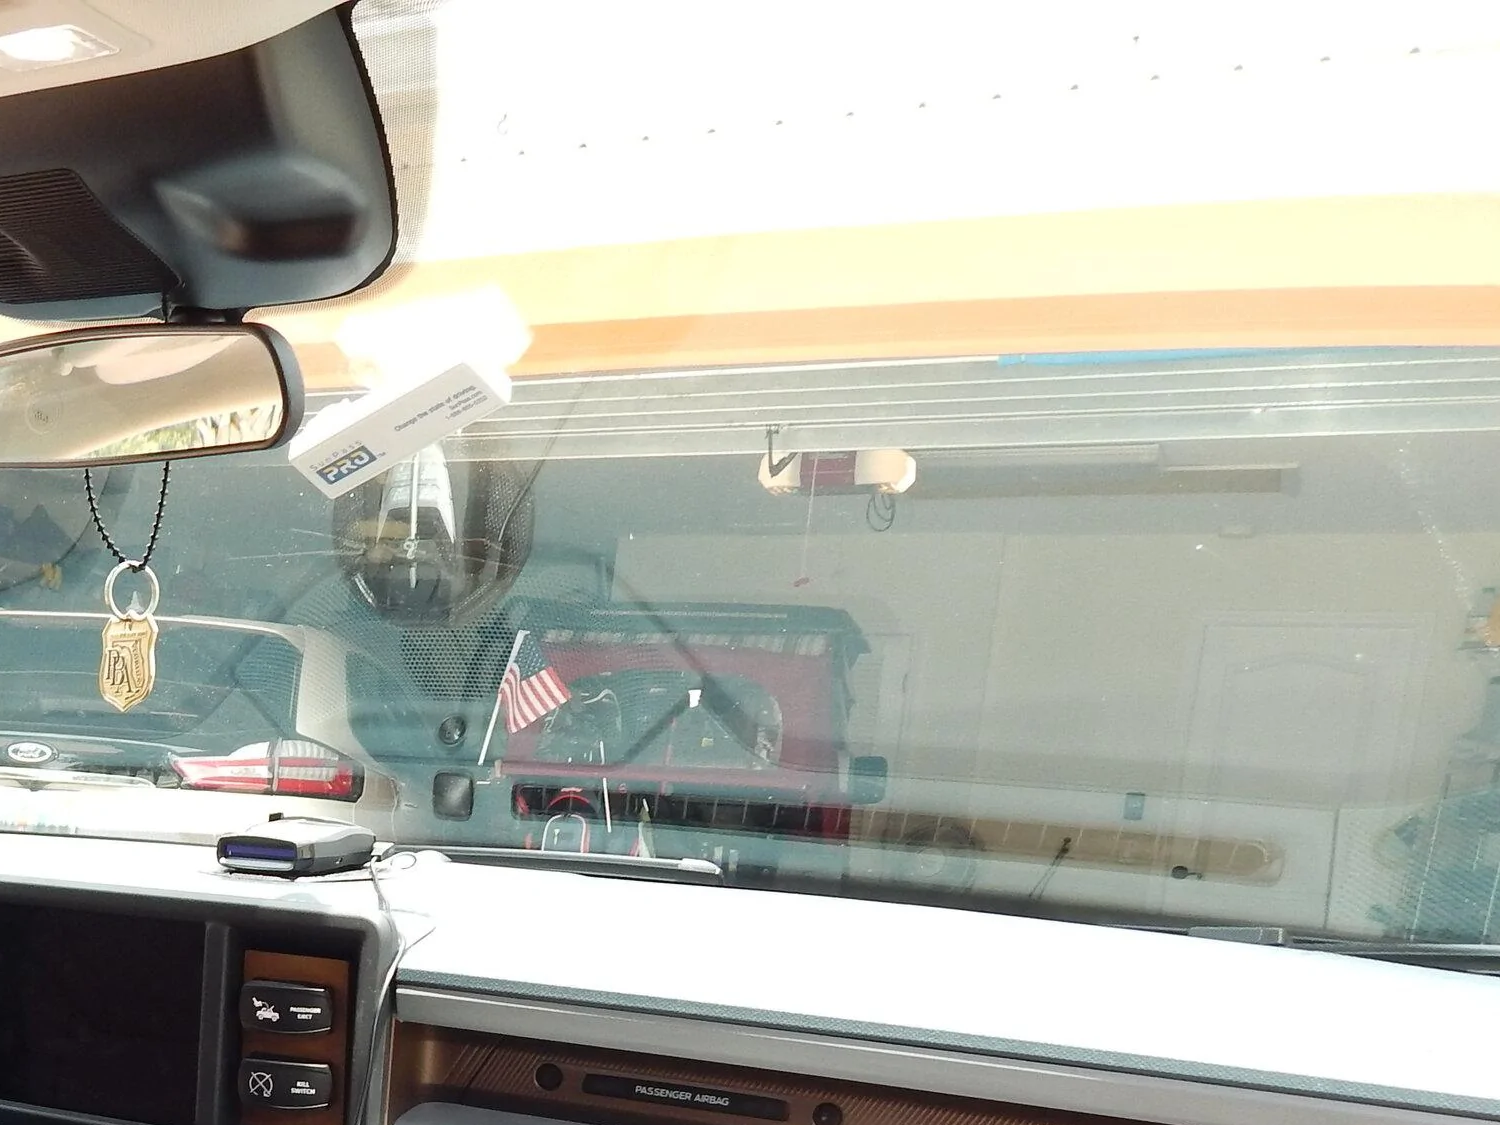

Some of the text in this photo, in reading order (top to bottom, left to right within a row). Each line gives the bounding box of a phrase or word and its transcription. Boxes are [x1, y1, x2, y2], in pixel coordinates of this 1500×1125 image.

[309, 441, 362, 471] SunPass
[323, 450, 370, 481] PRO
[106, 649, 133, 693] PBA
[290, 1087, 316, 1095] SWITCH
[635, 1085, 730, 1106] PASSENGER AIRBAG
